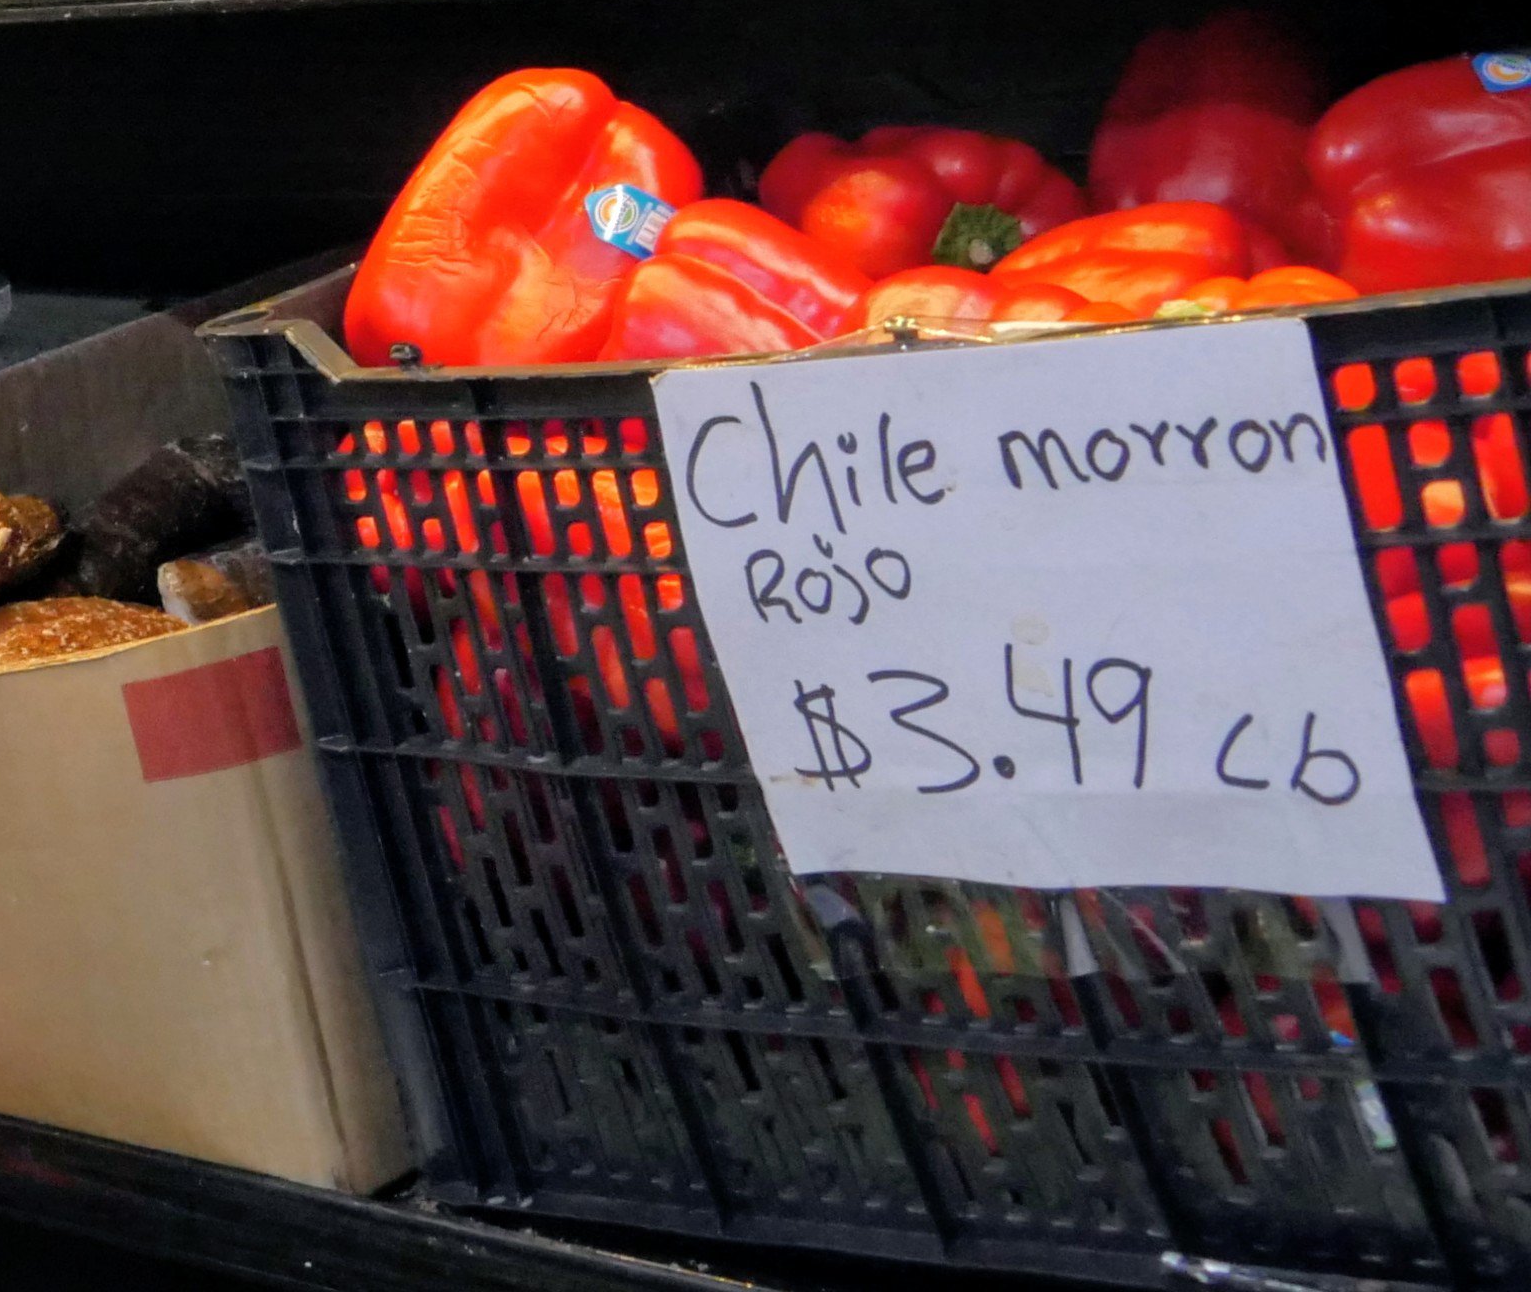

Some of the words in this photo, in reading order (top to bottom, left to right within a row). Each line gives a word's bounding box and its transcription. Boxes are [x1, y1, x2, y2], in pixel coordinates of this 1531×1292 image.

[686, 382, 947, 533] Chile
[999, 411, 1330, 492] morron
[794, 643, 1153, 795] $3.49
